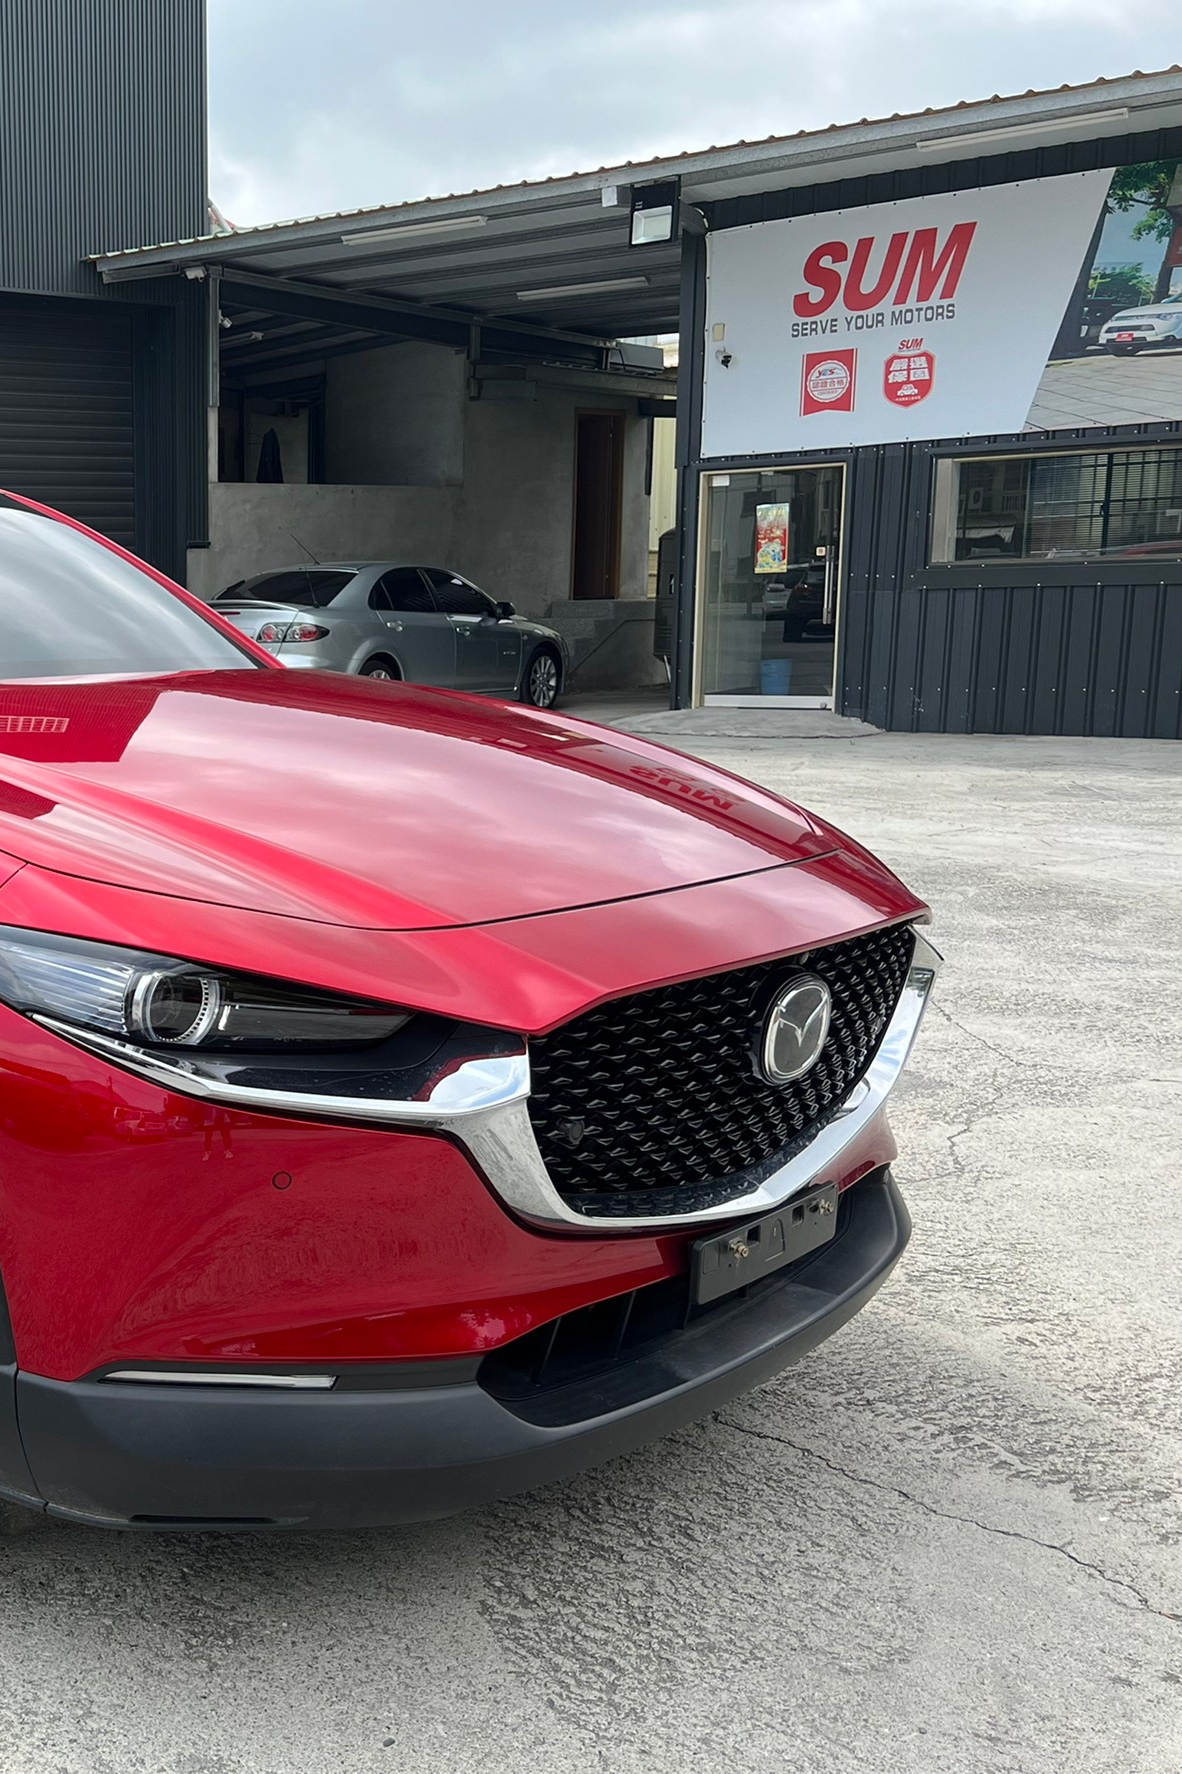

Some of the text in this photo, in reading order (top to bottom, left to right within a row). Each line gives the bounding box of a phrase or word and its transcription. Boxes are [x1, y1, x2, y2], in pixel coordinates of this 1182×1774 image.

[793, 221, 978, 318] SUM
[791, 303, 956, 338] SERVE YOUR MOTORS
[898, 337, 924, 351] SUM
